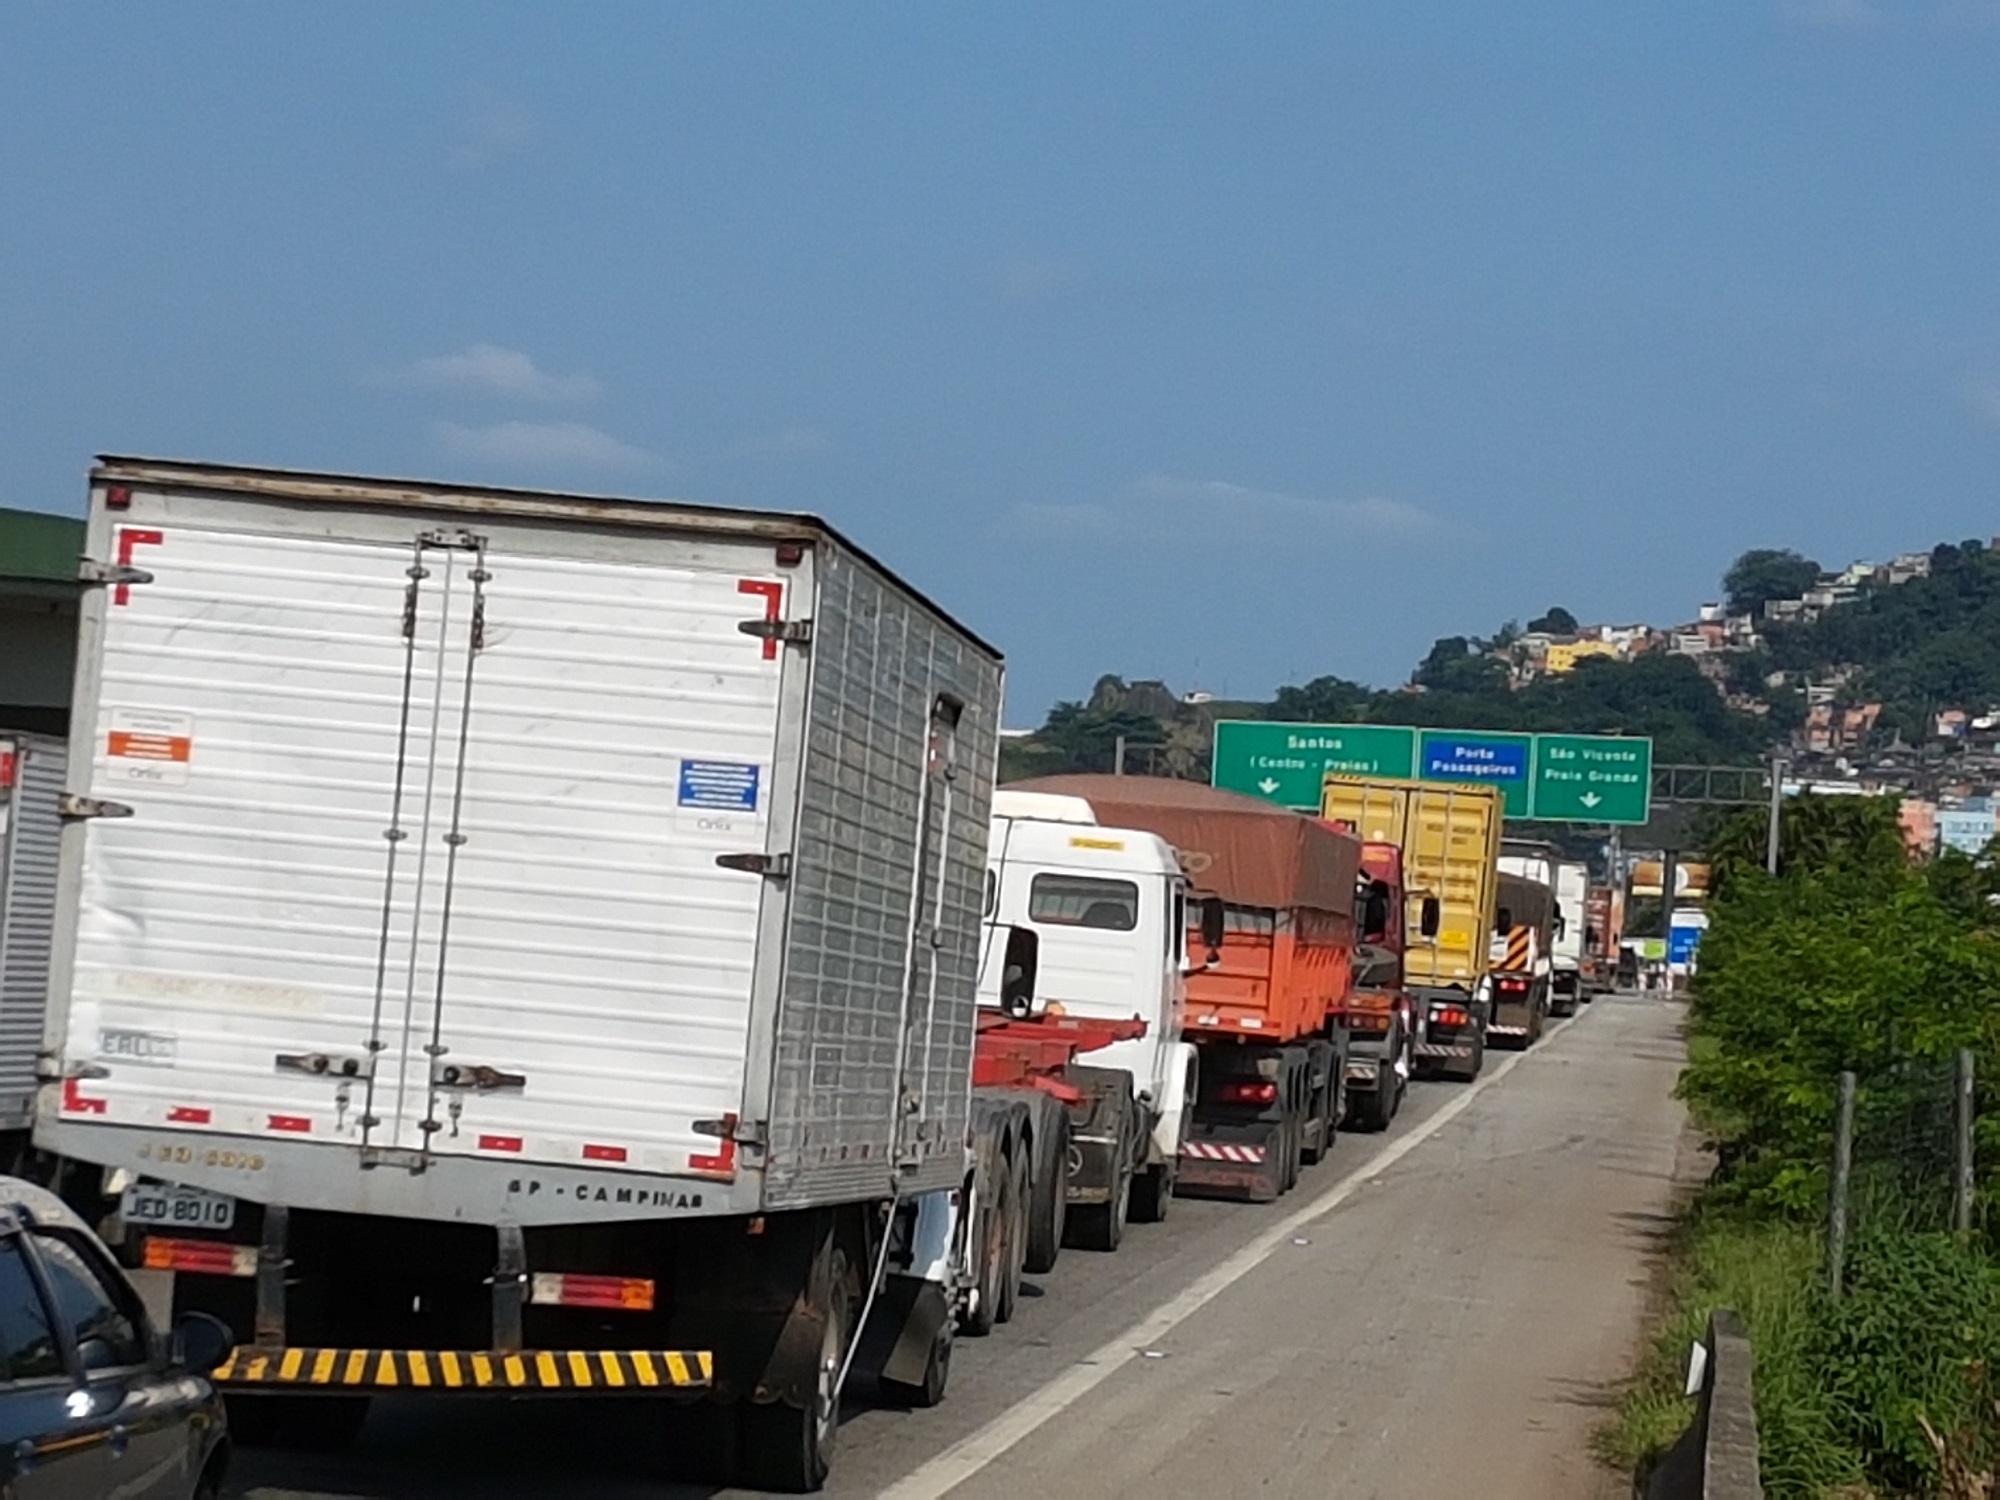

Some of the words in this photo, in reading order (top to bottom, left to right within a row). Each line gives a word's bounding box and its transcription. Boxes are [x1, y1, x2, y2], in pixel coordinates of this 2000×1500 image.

[1288, 736, 1342, 749] Santos
[1456, 746, 1494, 760] Porto
[1582, 749, 1636, 762] Vicente
[1432, 760, 1517, 776] Passageiros
[1545, 768, 1582, 781] Praia
[1588, 770, 1639, 783] Grande
[576, 1185, 703, 1209] CAMPINAS
